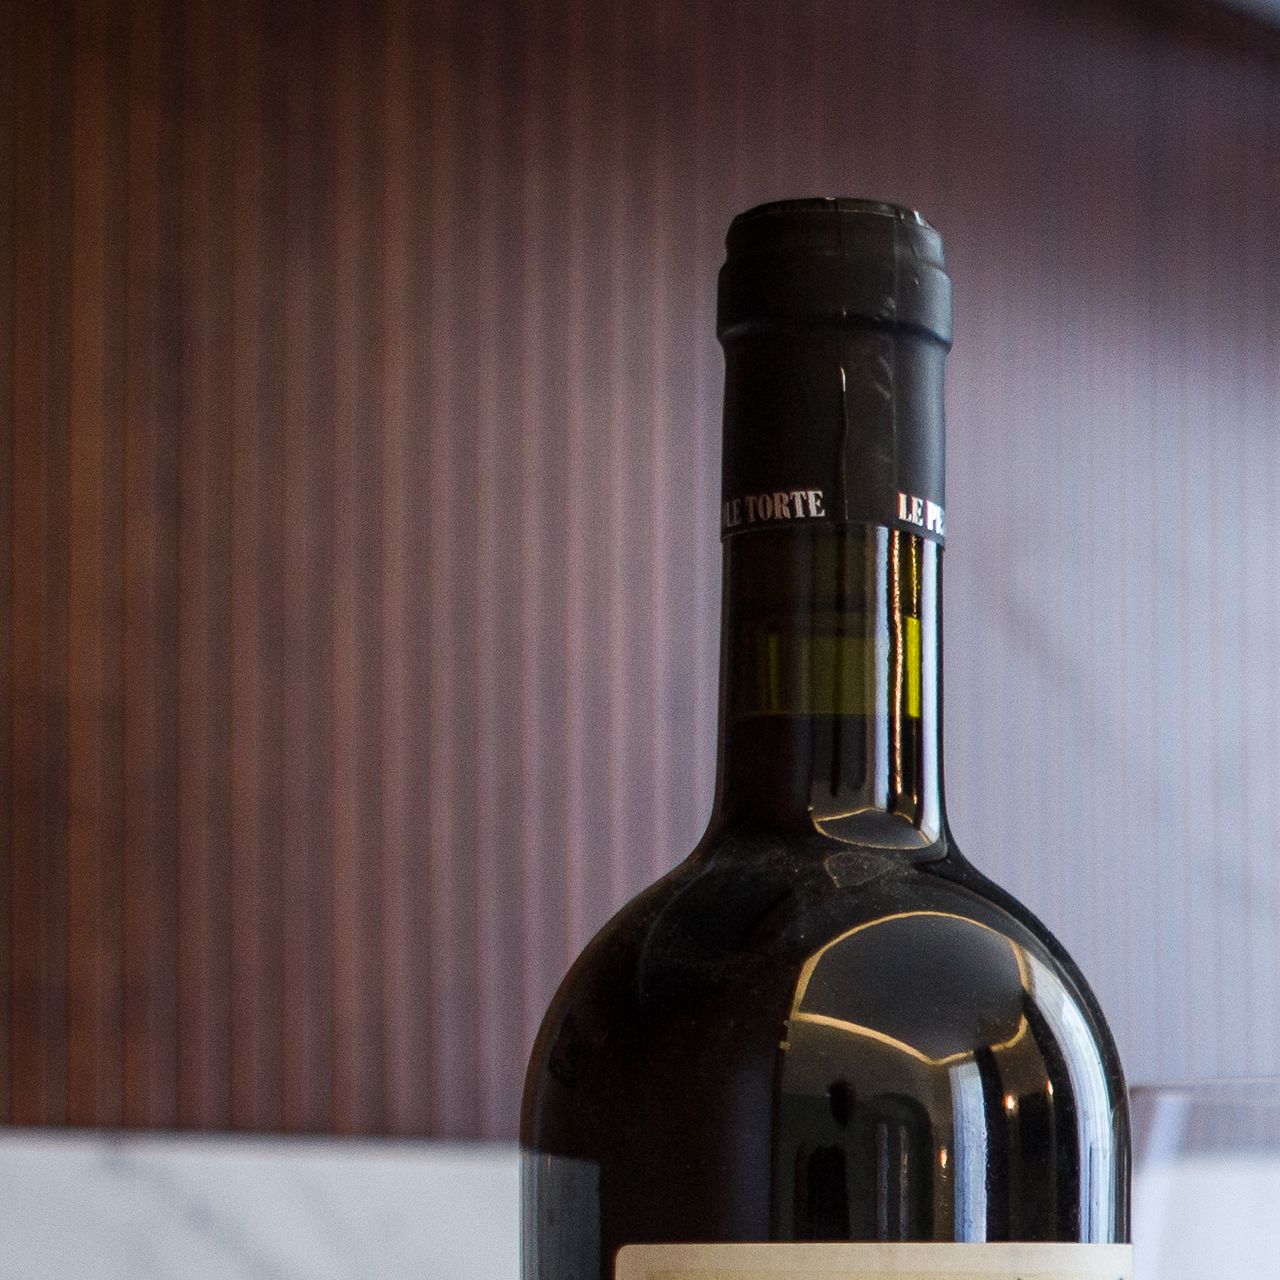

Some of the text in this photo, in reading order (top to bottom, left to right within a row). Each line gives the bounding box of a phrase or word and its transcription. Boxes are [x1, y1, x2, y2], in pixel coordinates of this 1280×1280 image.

[723, 490, 826, 528] LE TORTE
[897, 492, 924, 527] LE
